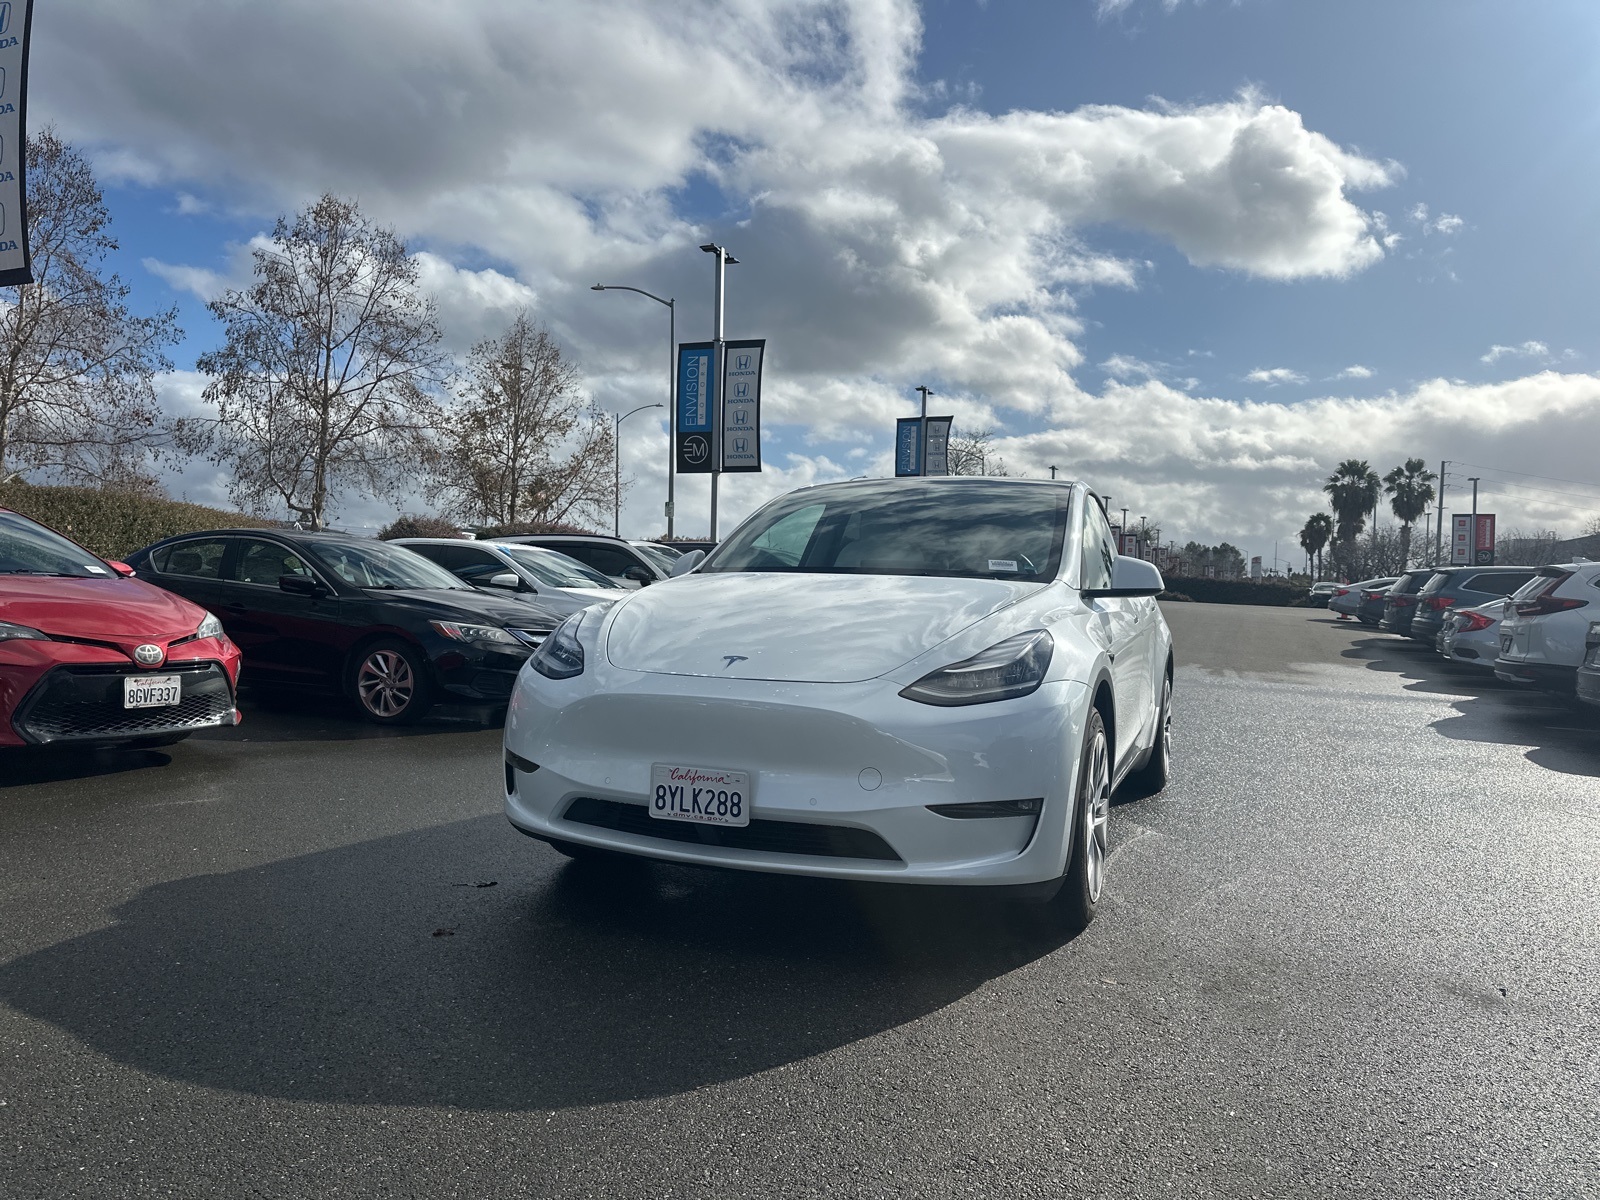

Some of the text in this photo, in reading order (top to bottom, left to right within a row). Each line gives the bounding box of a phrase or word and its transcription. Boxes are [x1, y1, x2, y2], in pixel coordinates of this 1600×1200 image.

[685, 356, 699, 426] ENVISION
[901, 425, 911, 470] ENVISION
[128, 686, 178, 704] 8GVF337
[670, 767, 731, 786] California
[655, 784, 742, 818] 8YLK288
[672, 812, 724, 822] dmv.ca.gov
